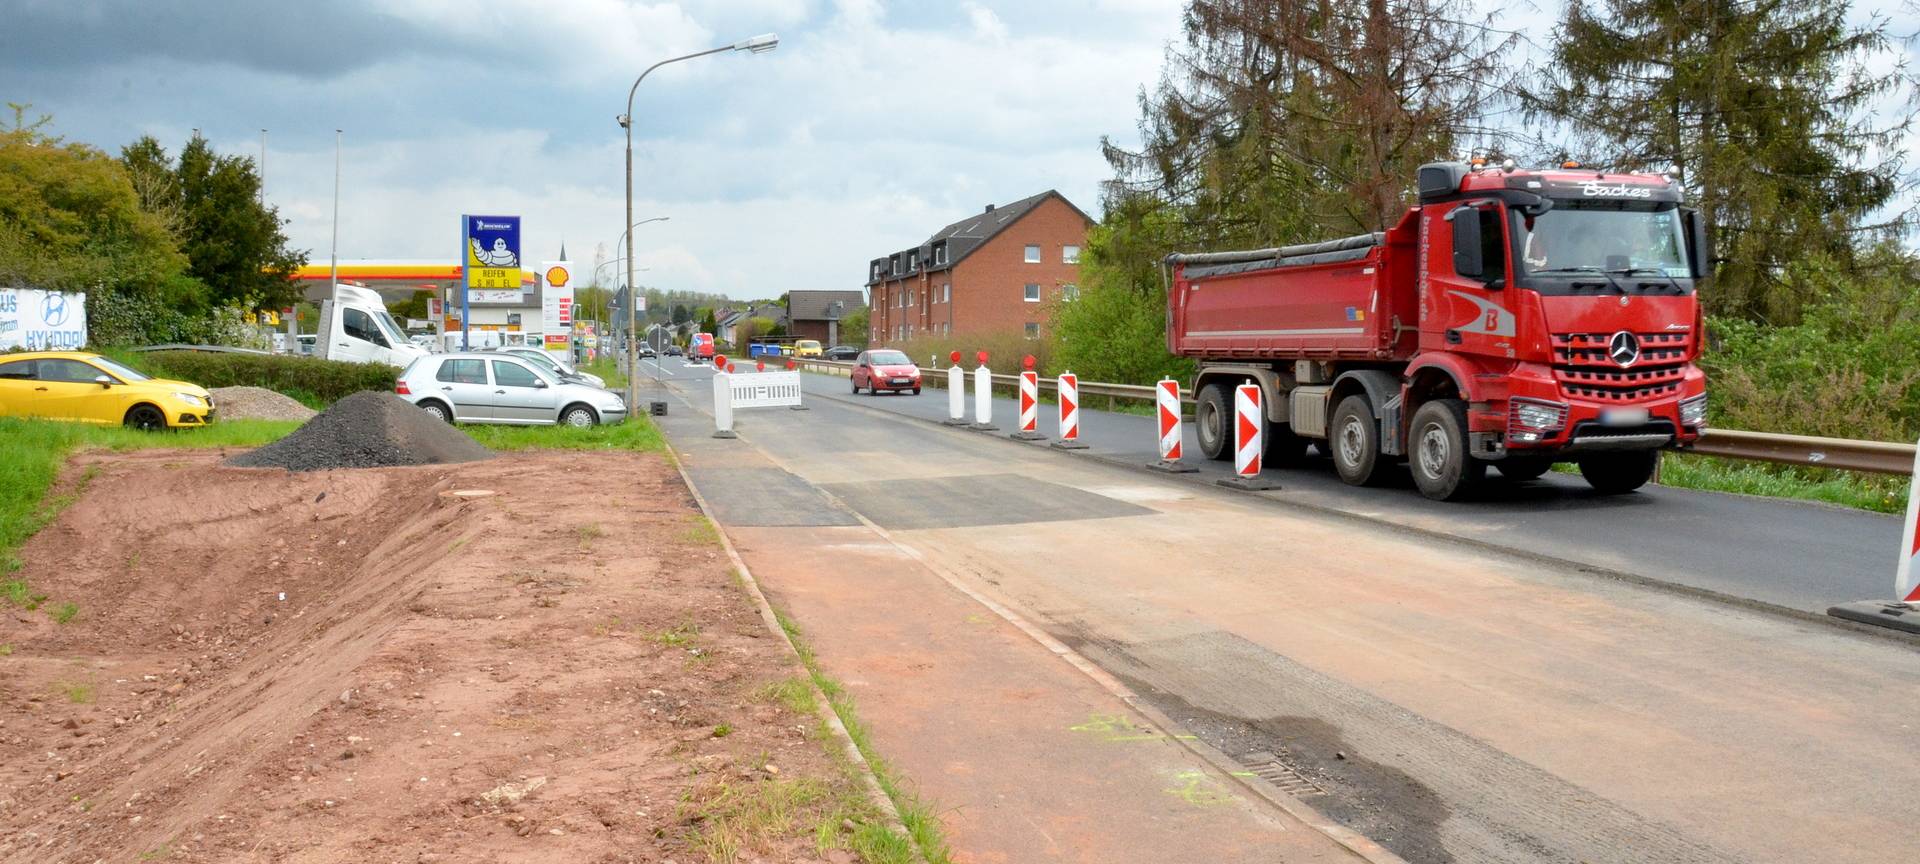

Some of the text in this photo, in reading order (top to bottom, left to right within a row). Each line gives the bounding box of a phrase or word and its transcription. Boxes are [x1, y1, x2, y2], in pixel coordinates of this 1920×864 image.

[1578, 181, 1651, 198] Backes
[482, 269, 506, 278] REIFEN
[0, 294, 17, 313] US
